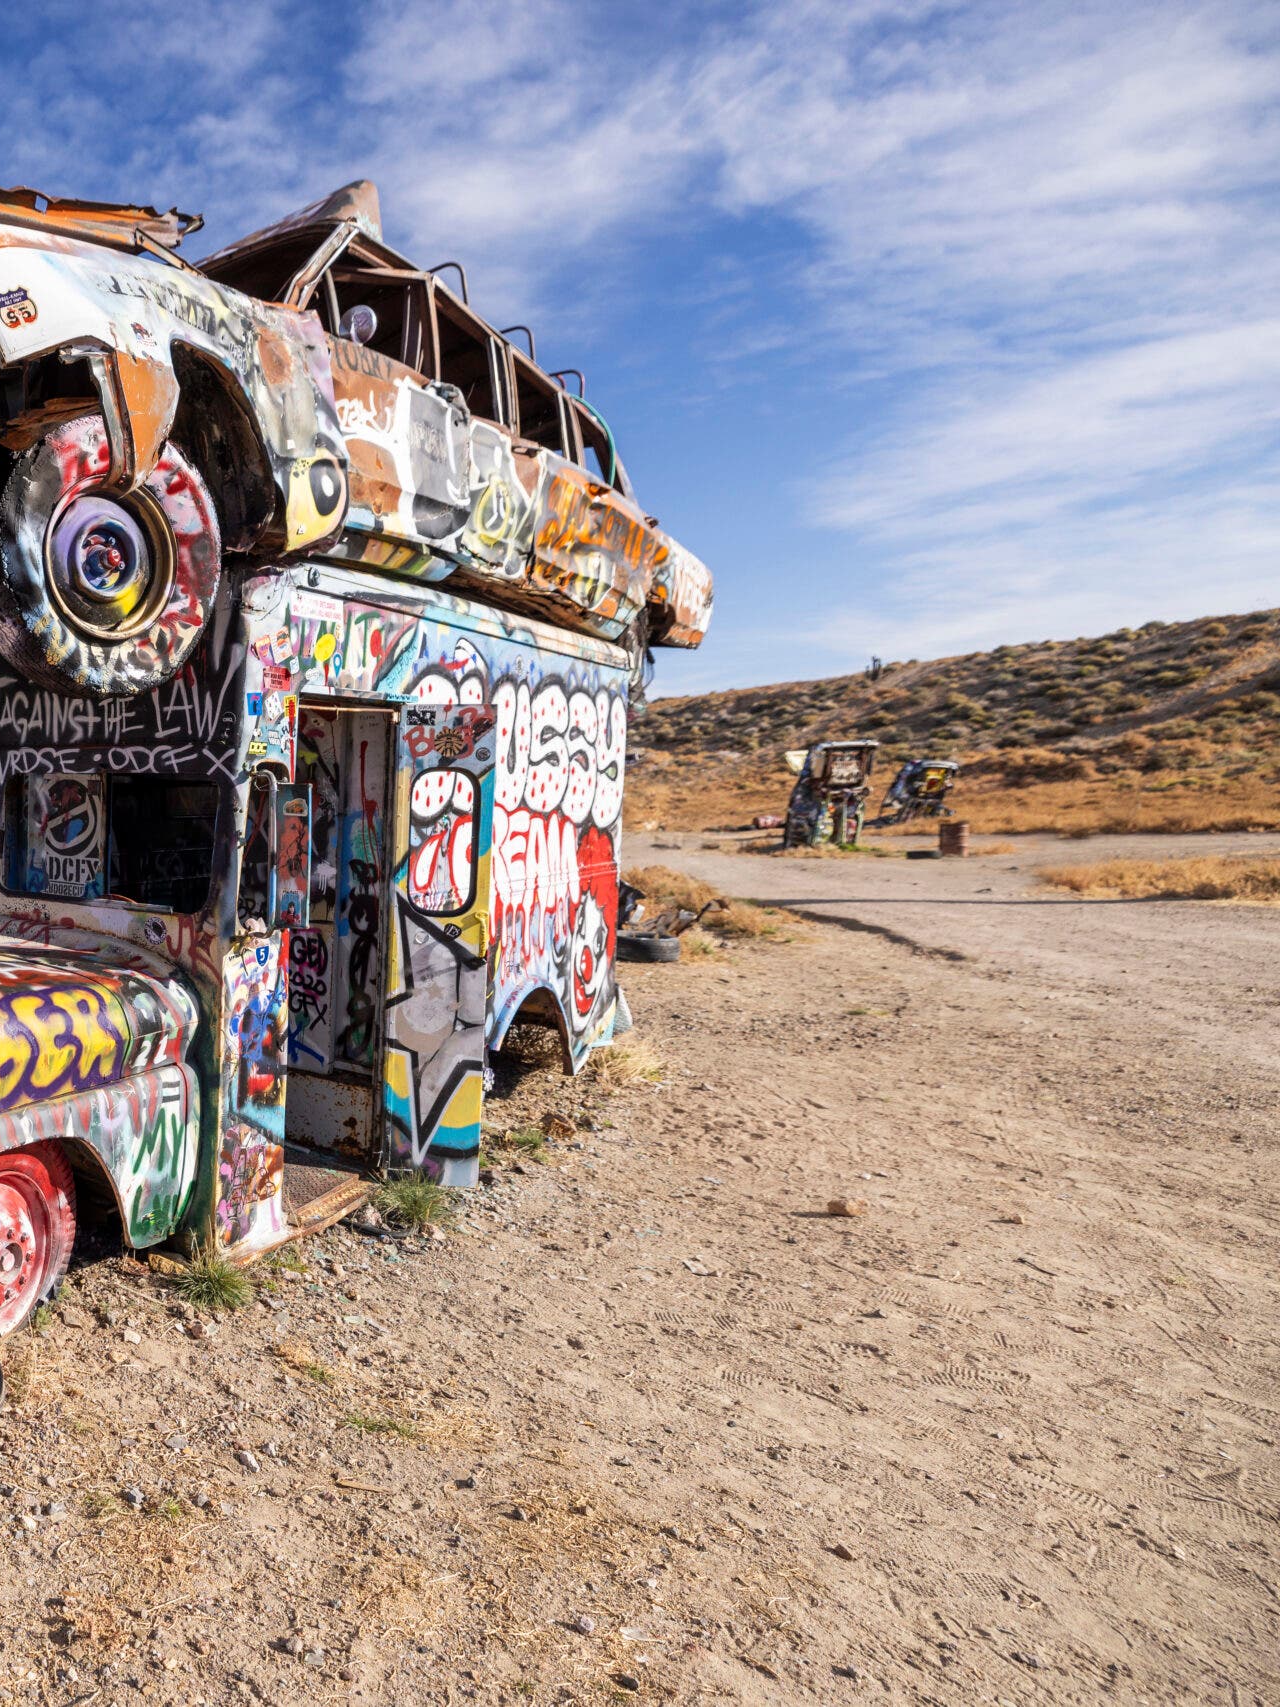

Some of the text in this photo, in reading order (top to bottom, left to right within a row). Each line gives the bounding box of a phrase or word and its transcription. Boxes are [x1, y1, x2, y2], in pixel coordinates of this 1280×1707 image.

[98, 696, 145, 742] THE
[151, 662, 243, 742] LAW
[133, 1034, 170, 1069] 21
[132, 1106, 187, 1179] MY
